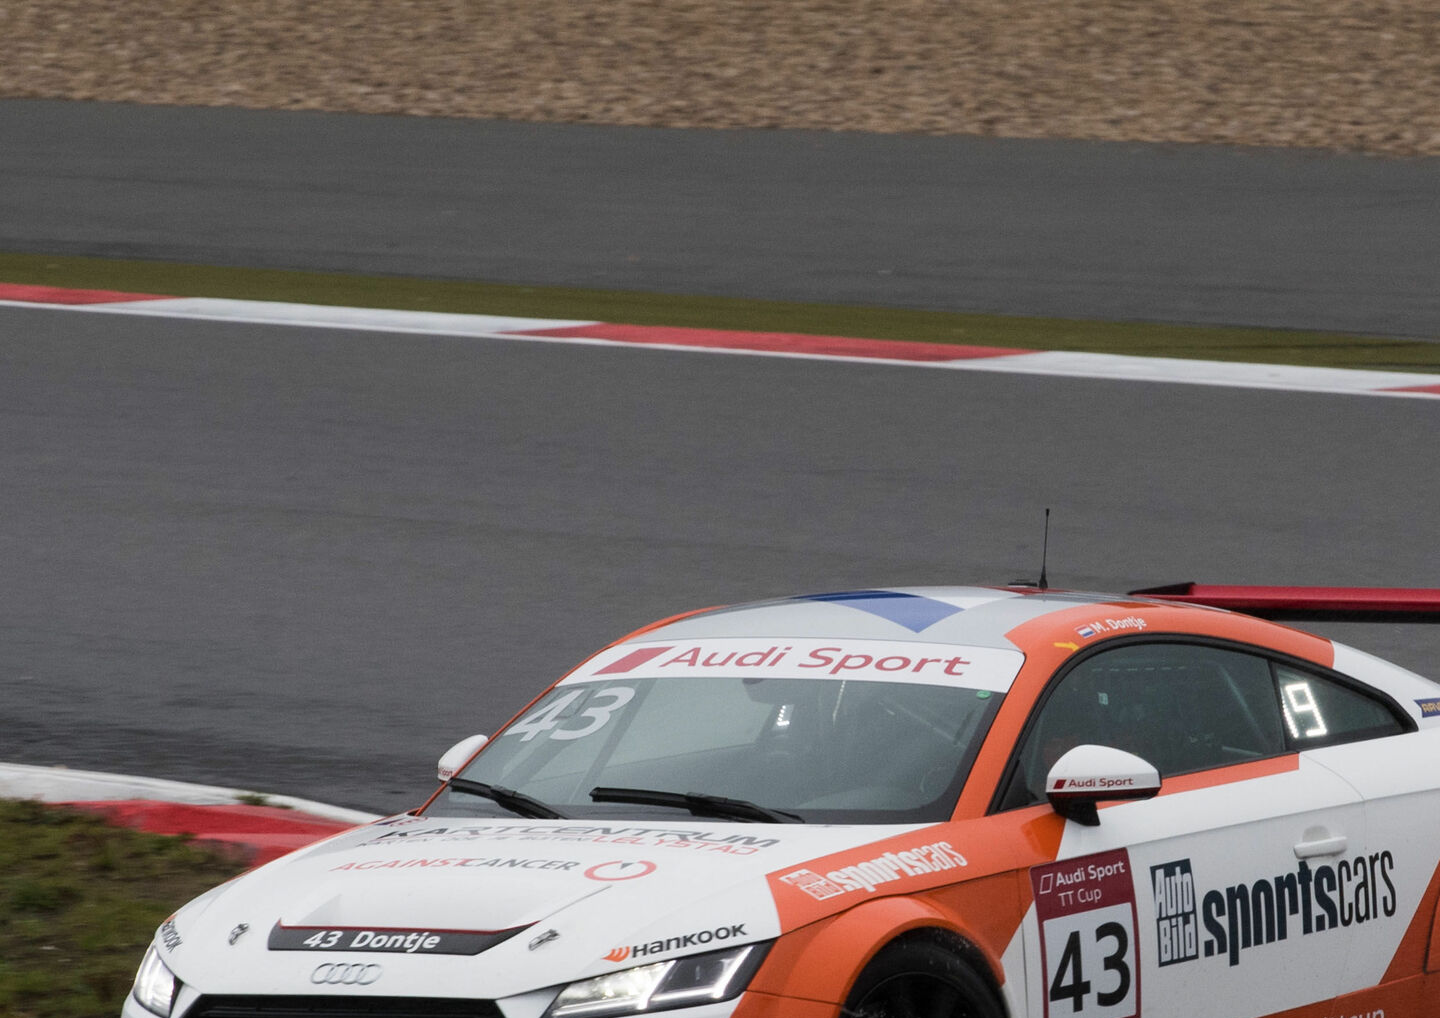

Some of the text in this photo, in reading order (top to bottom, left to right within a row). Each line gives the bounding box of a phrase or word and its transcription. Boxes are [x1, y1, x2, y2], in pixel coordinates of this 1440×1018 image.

[1106, 616, 1147, 631] Dontje
[659, 646, 971, 676] Audi Sport
[503, 686, 636, 742] 43
[1068, 777, 1134, 788] Audi Sport
[591, 835, 759, 856] LELYSTAD
[826, 841, 968, 892] sportscars
[1056, 861, 1126, 887] Audi Sport
[1059, 887, 1103, 907] TT Cup
[1154, 866, 1195, 918] Auto
[1202, 850, 1397, 967] sportscars
[303, 930, 442, 954] 43 Dontje
[1159, 914, 1198, 963] Bild
[1050, 921, 1131, 1013] 43
